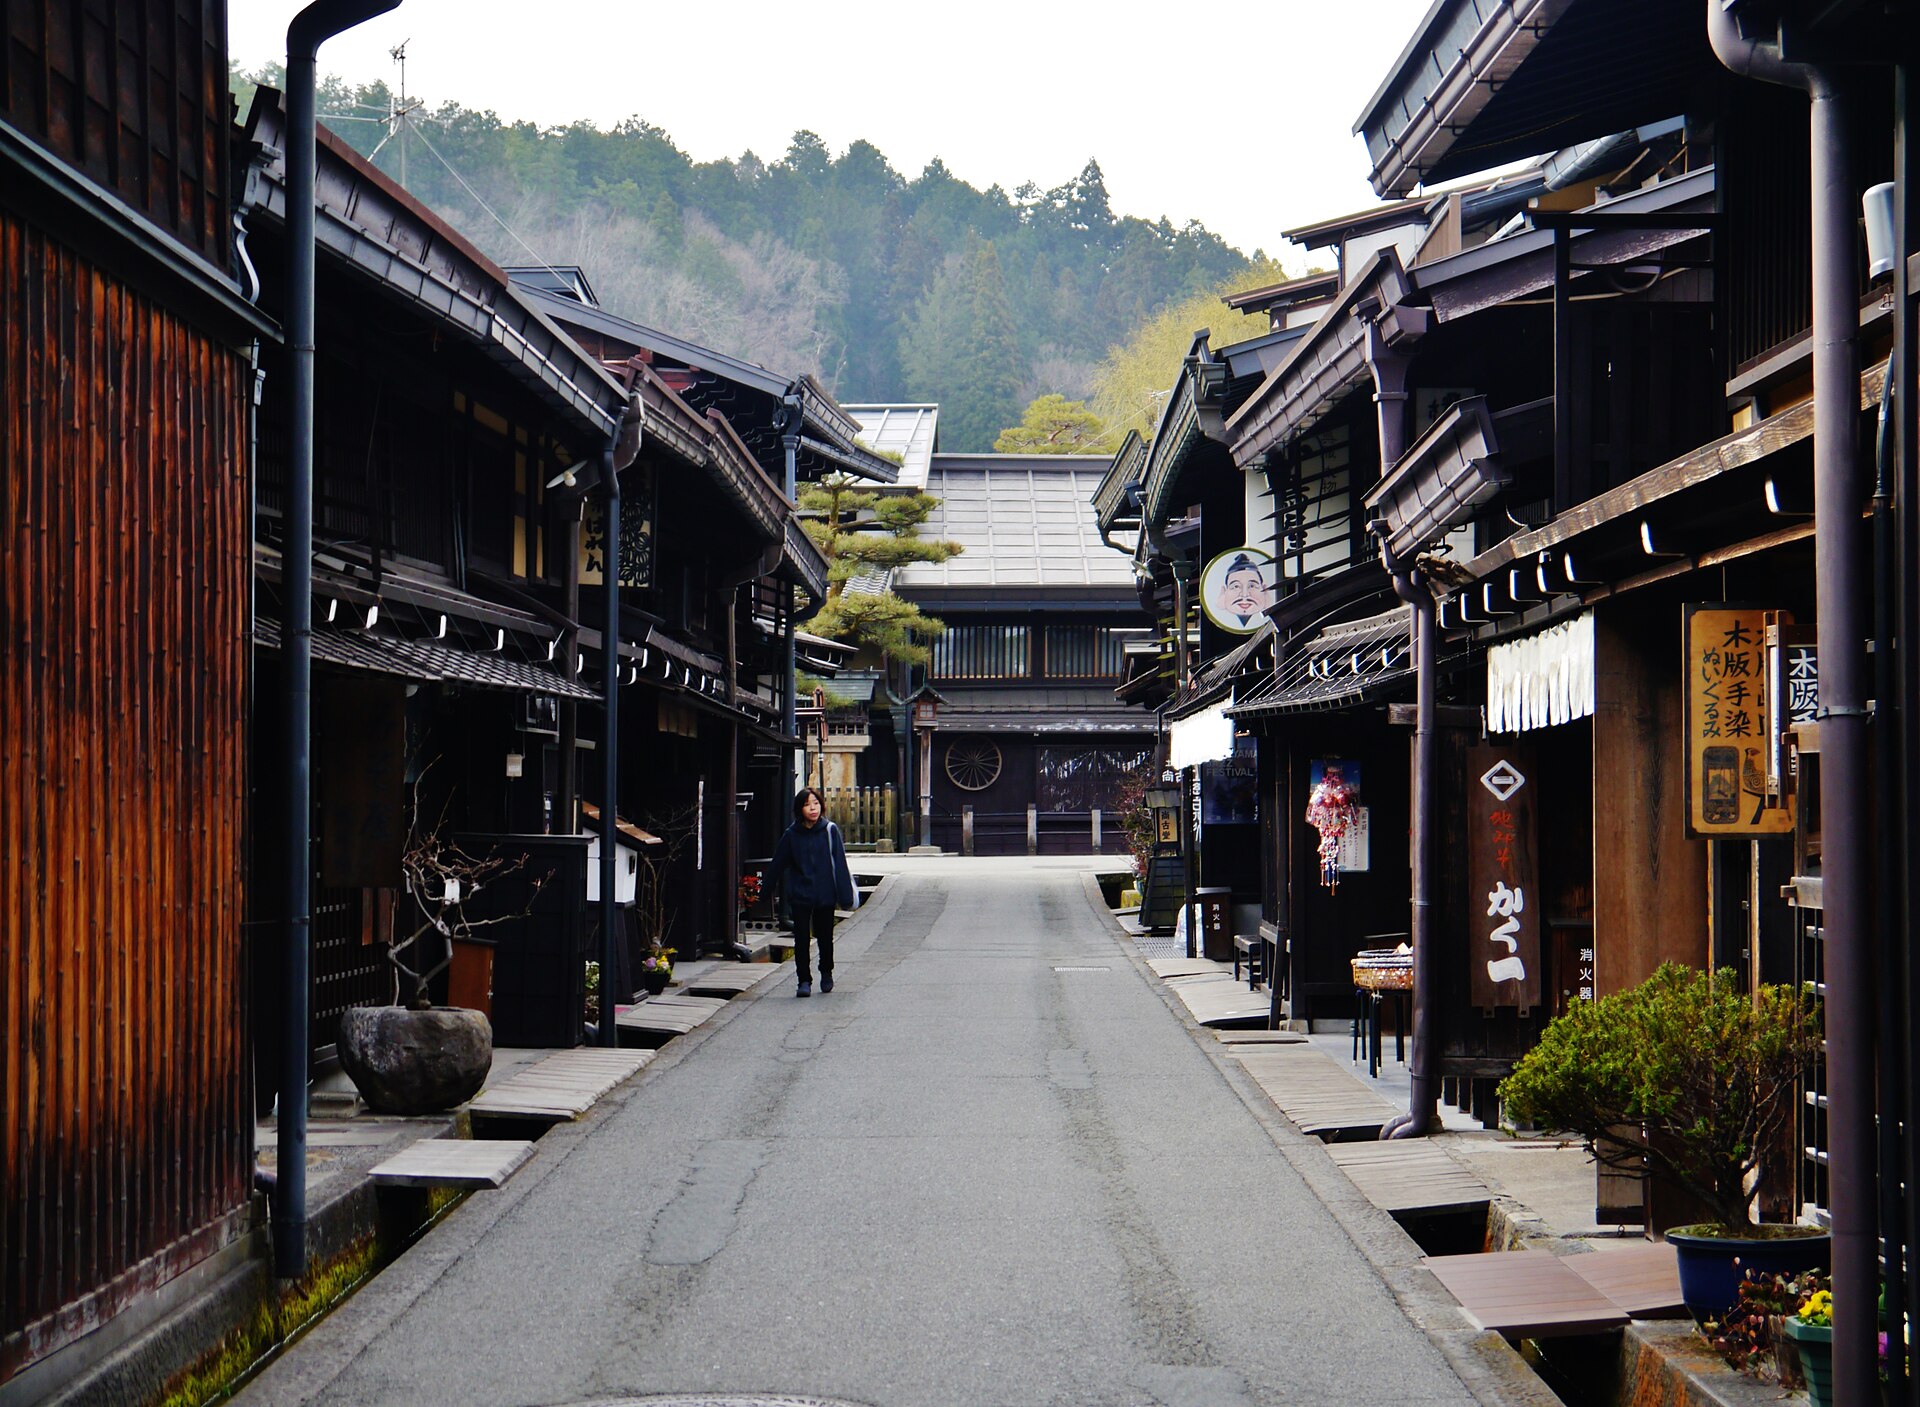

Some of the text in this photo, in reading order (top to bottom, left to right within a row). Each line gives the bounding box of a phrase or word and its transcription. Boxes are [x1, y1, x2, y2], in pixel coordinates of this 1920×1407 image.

[1702, 646, 1722, 738] ぬいぐるみ
[1722, 619, 1752, 738] 木版手染
[1206, 768, 1254, 778] FESTIVAL
[1212, 903, 1222, 931] 消火器
[1487, 881, 1526, 983] かく一
[1579, 948, 1593, 1000] 消火器
